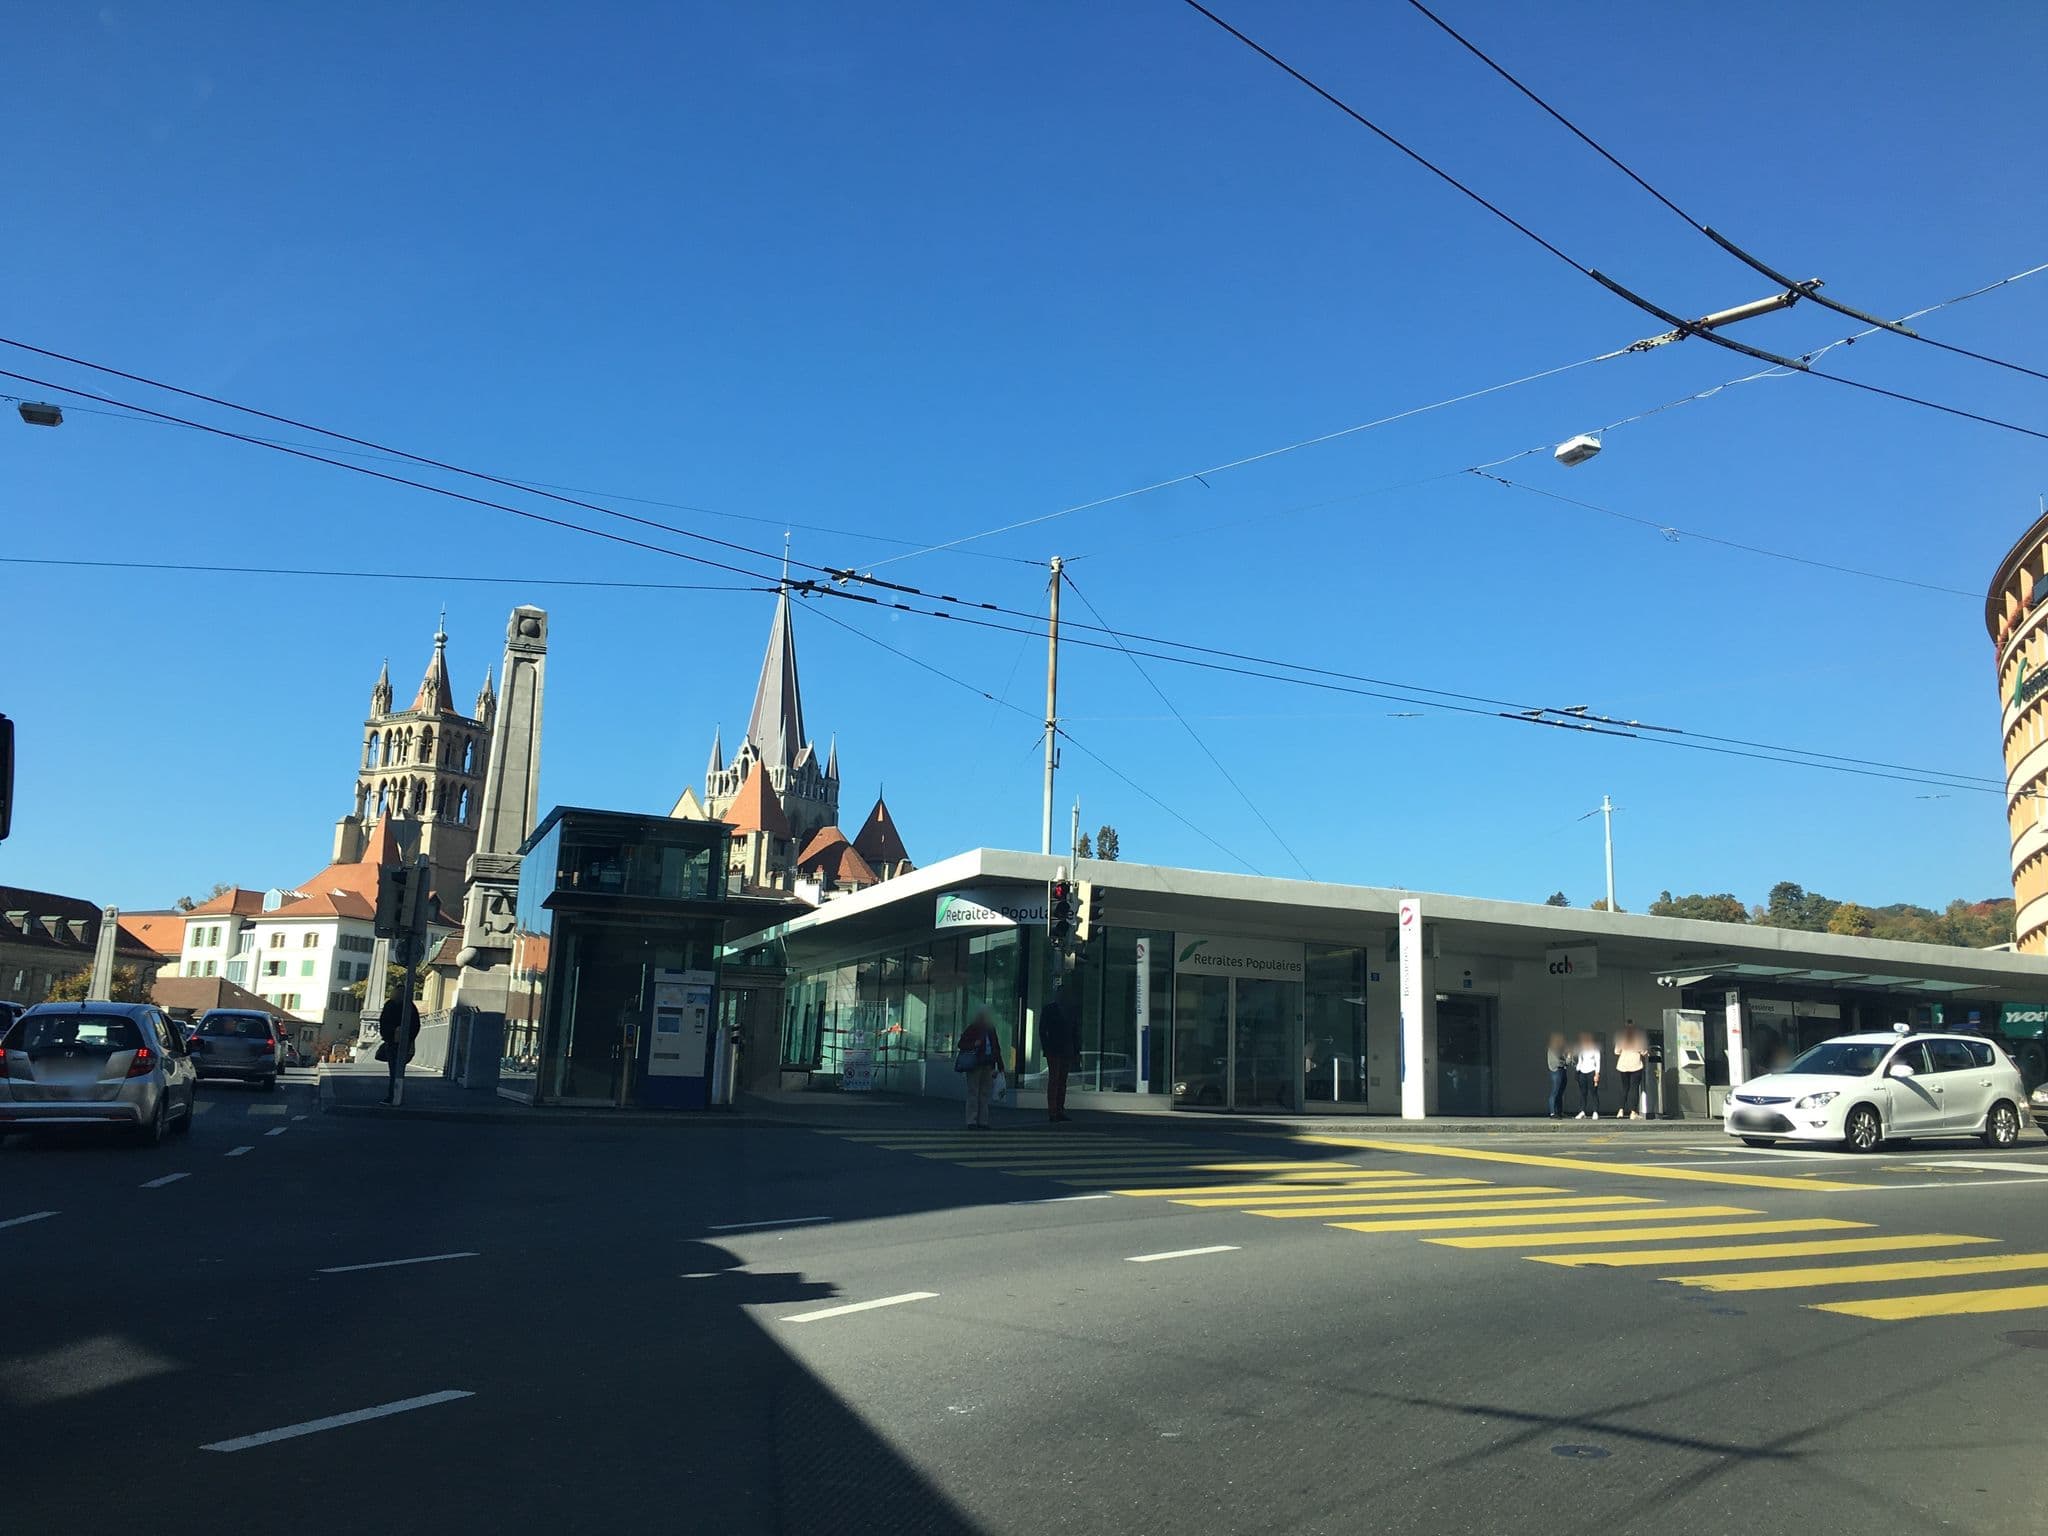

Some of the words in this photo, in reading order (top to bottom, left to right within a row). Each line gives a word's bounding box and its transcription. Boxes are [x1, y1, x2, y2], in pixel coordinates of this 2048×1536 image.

[946, 907, 996, 922] Retraites
[1194, 953, 1243, 968] Retraites
[1246, 957, 1302, 972] Populaires
